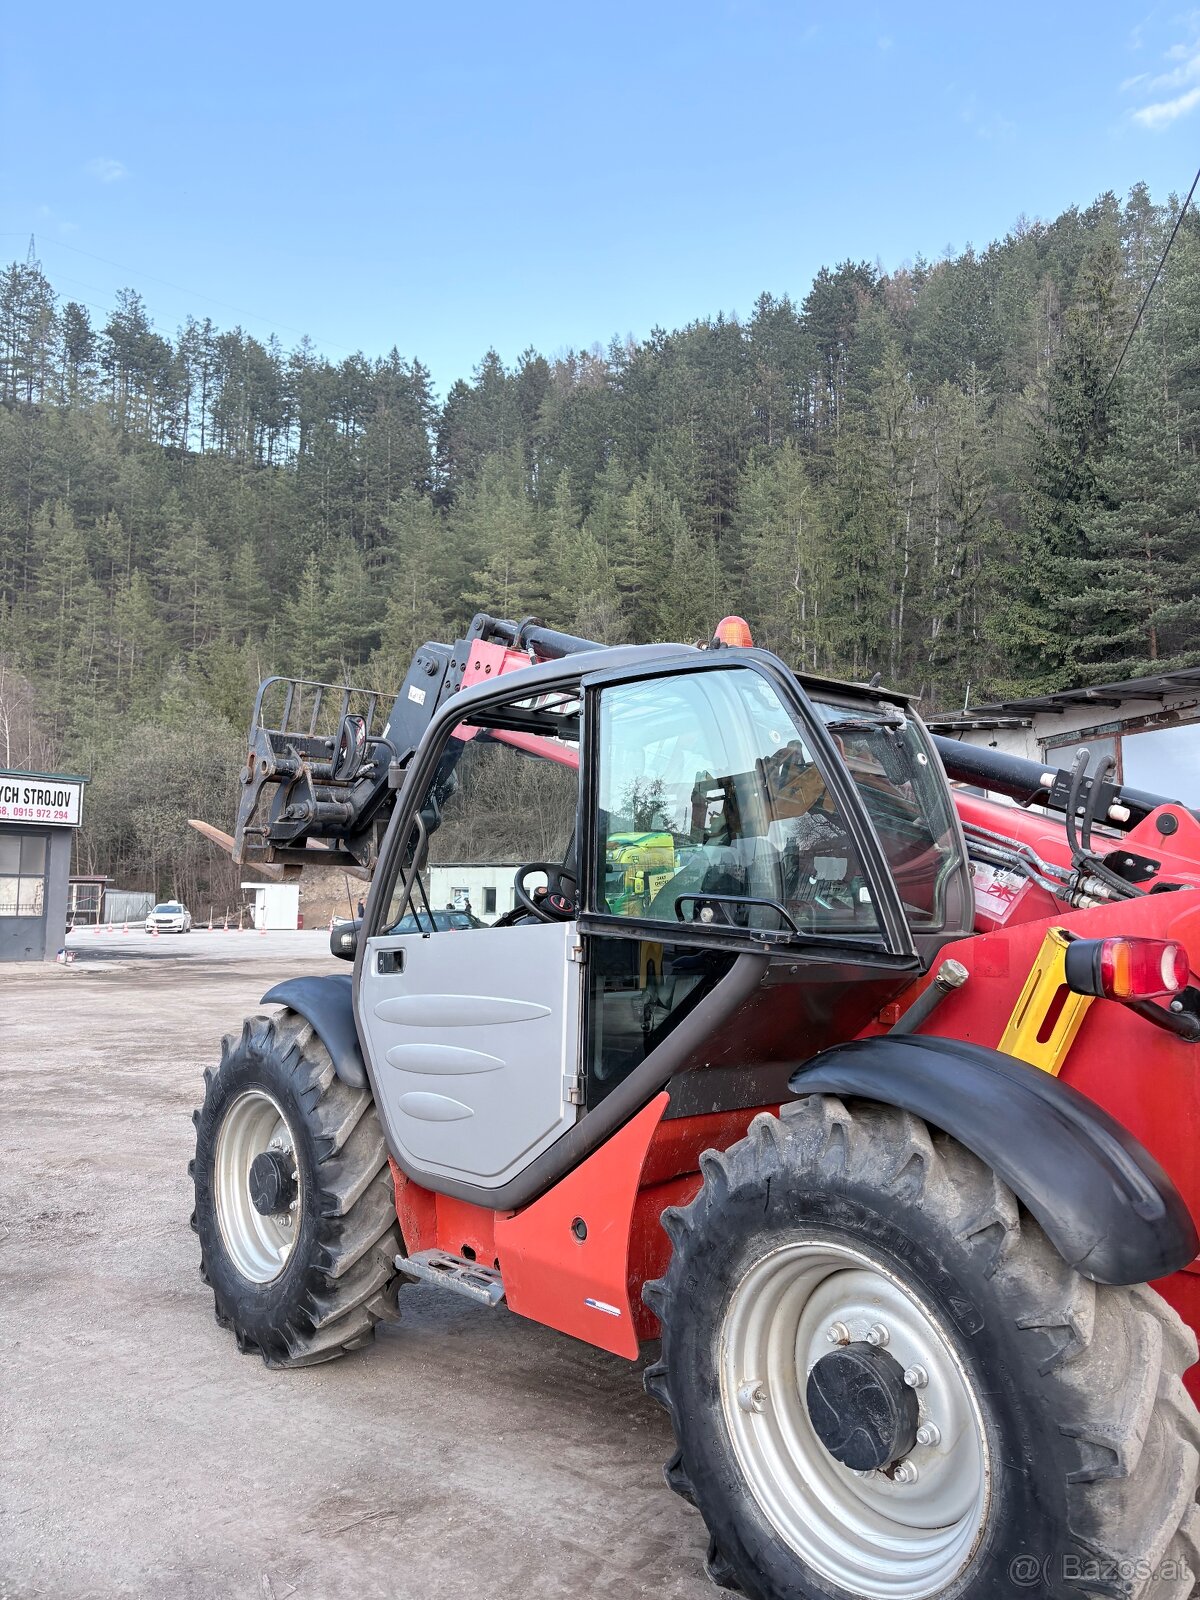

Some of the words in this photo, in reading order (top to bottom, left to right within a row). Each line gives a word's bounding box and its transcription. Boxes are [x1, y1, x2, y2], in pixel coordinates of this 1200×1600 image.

[23, 788, 71, 807] STROJOV
[0, 806, 9, 817] 8,
[13, 807, 33, 817] 0915
[36, 809, 51, 818] 972
[54, 810, 68, 819] 294
